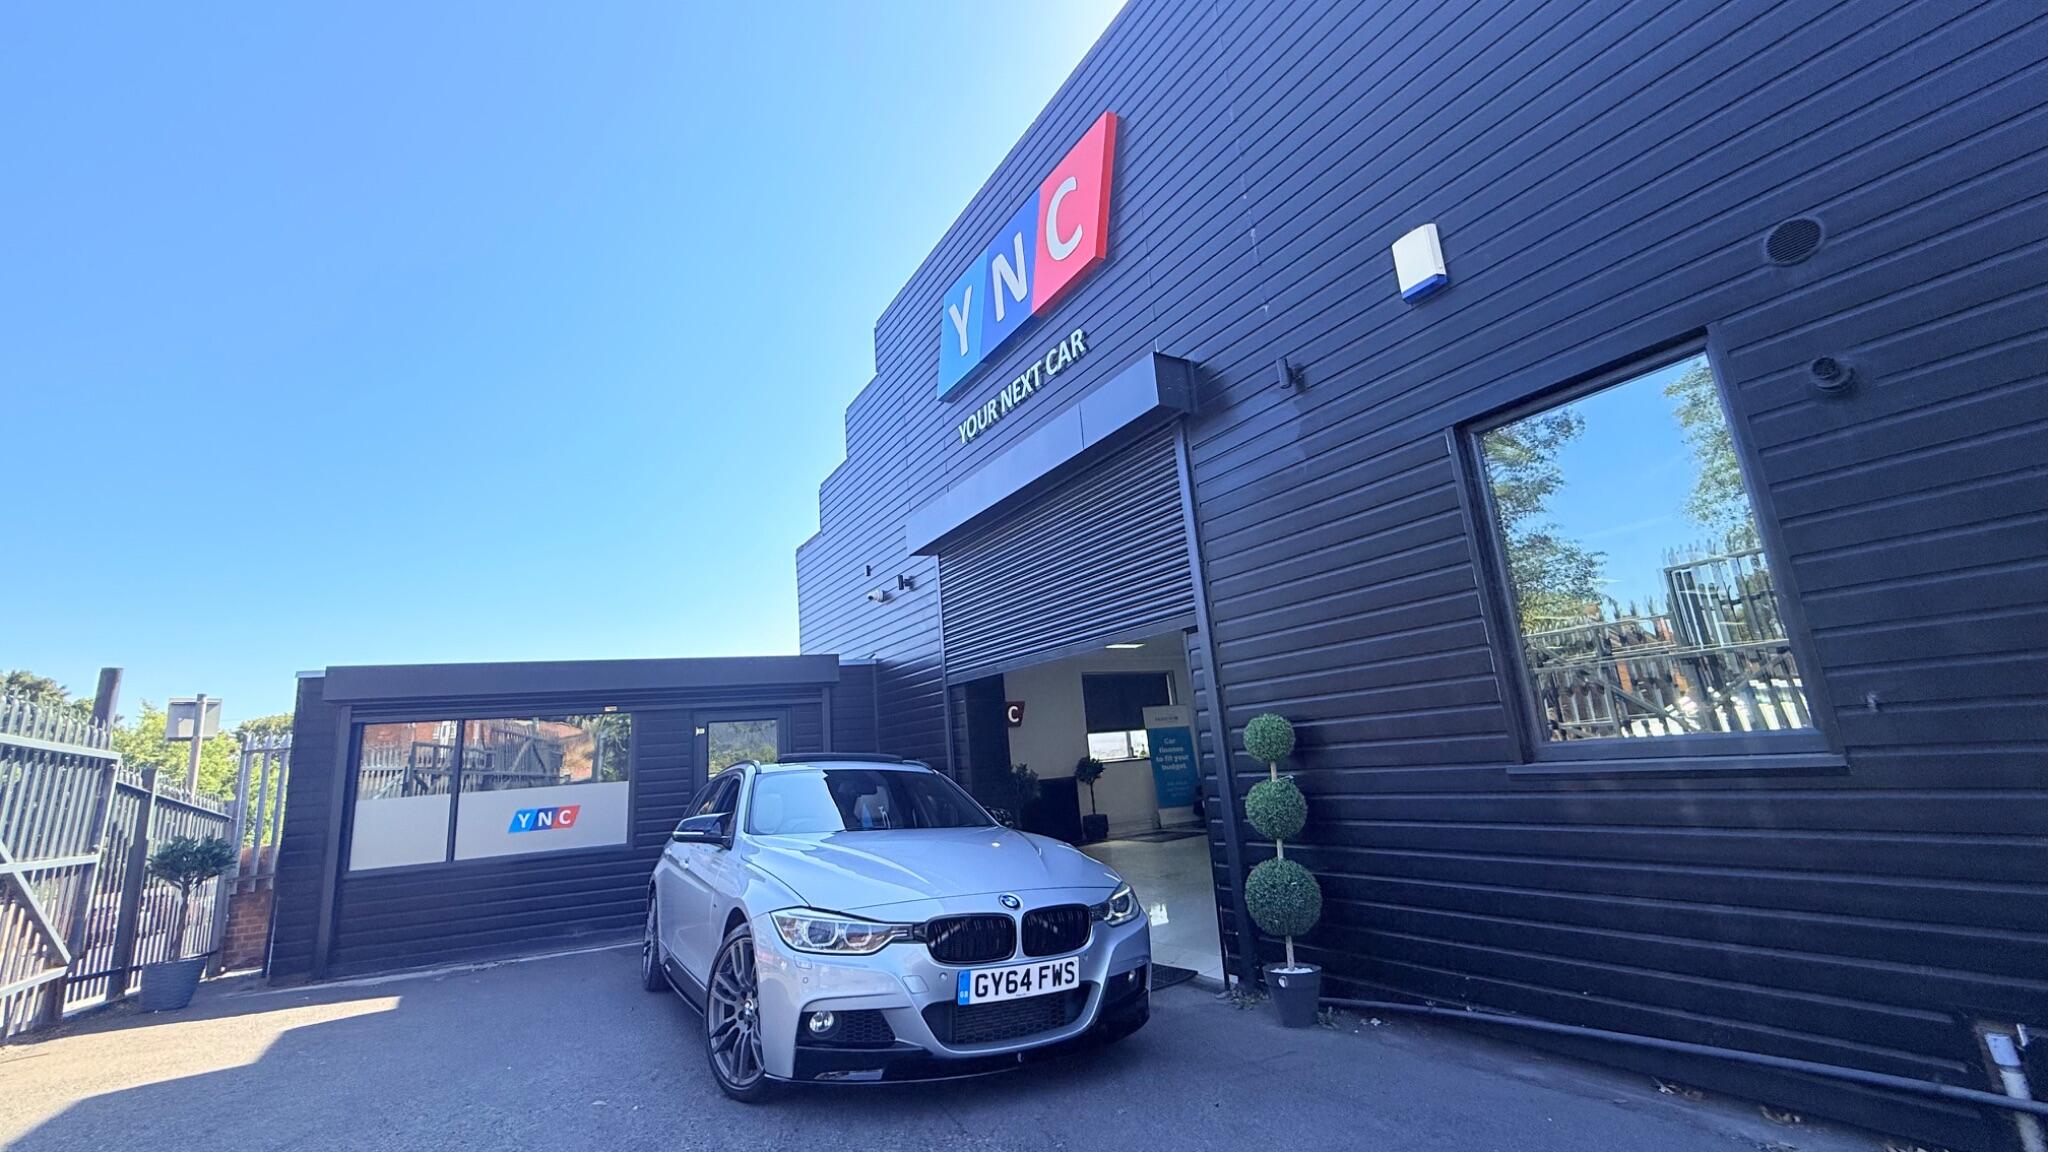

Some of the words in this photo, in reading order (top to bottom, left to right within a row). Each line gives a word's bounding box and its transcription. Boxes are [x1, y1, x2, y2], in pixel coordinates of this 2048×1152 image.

[948, 176, 1083, 357] YNC
[958, 399, 998, 444] YOUR
[1000, 360, 1041, 413] NEXT
[1045, 328, 1086, 376] CAR
[517, 809, 571, 829] YNC
[974, 968, 1032, 998] GY64
[1038, 961, 1075, 989] FWS
